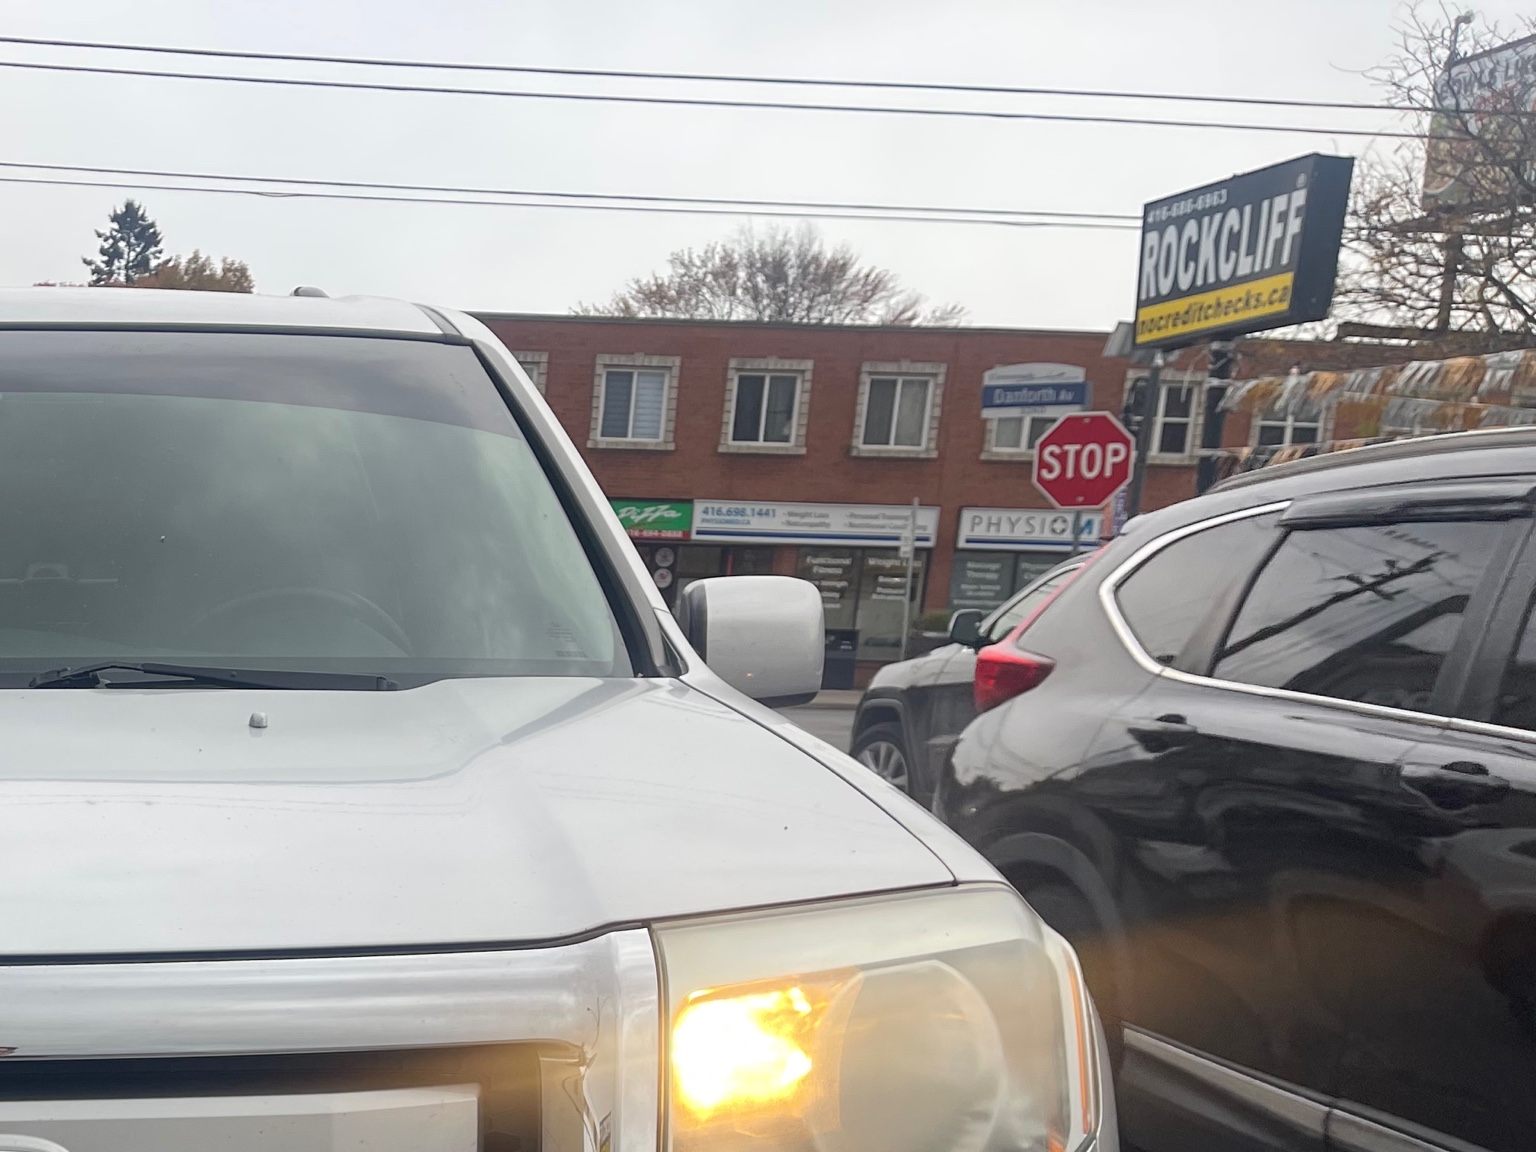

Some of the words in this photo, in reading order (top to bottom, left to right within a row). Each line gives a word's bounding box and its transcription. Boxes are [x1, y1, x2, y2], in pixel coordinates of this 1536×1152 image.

[1140, 187, 1308, 301] ROCKCLIFF
[1138, 284, 1292, 336] nocreditchecks.ca
[993, 387, 1056, 404] Danforth
[1040, 442, 1128, 480] STOP
[702, 506, 776, 518] 416.698.1441
